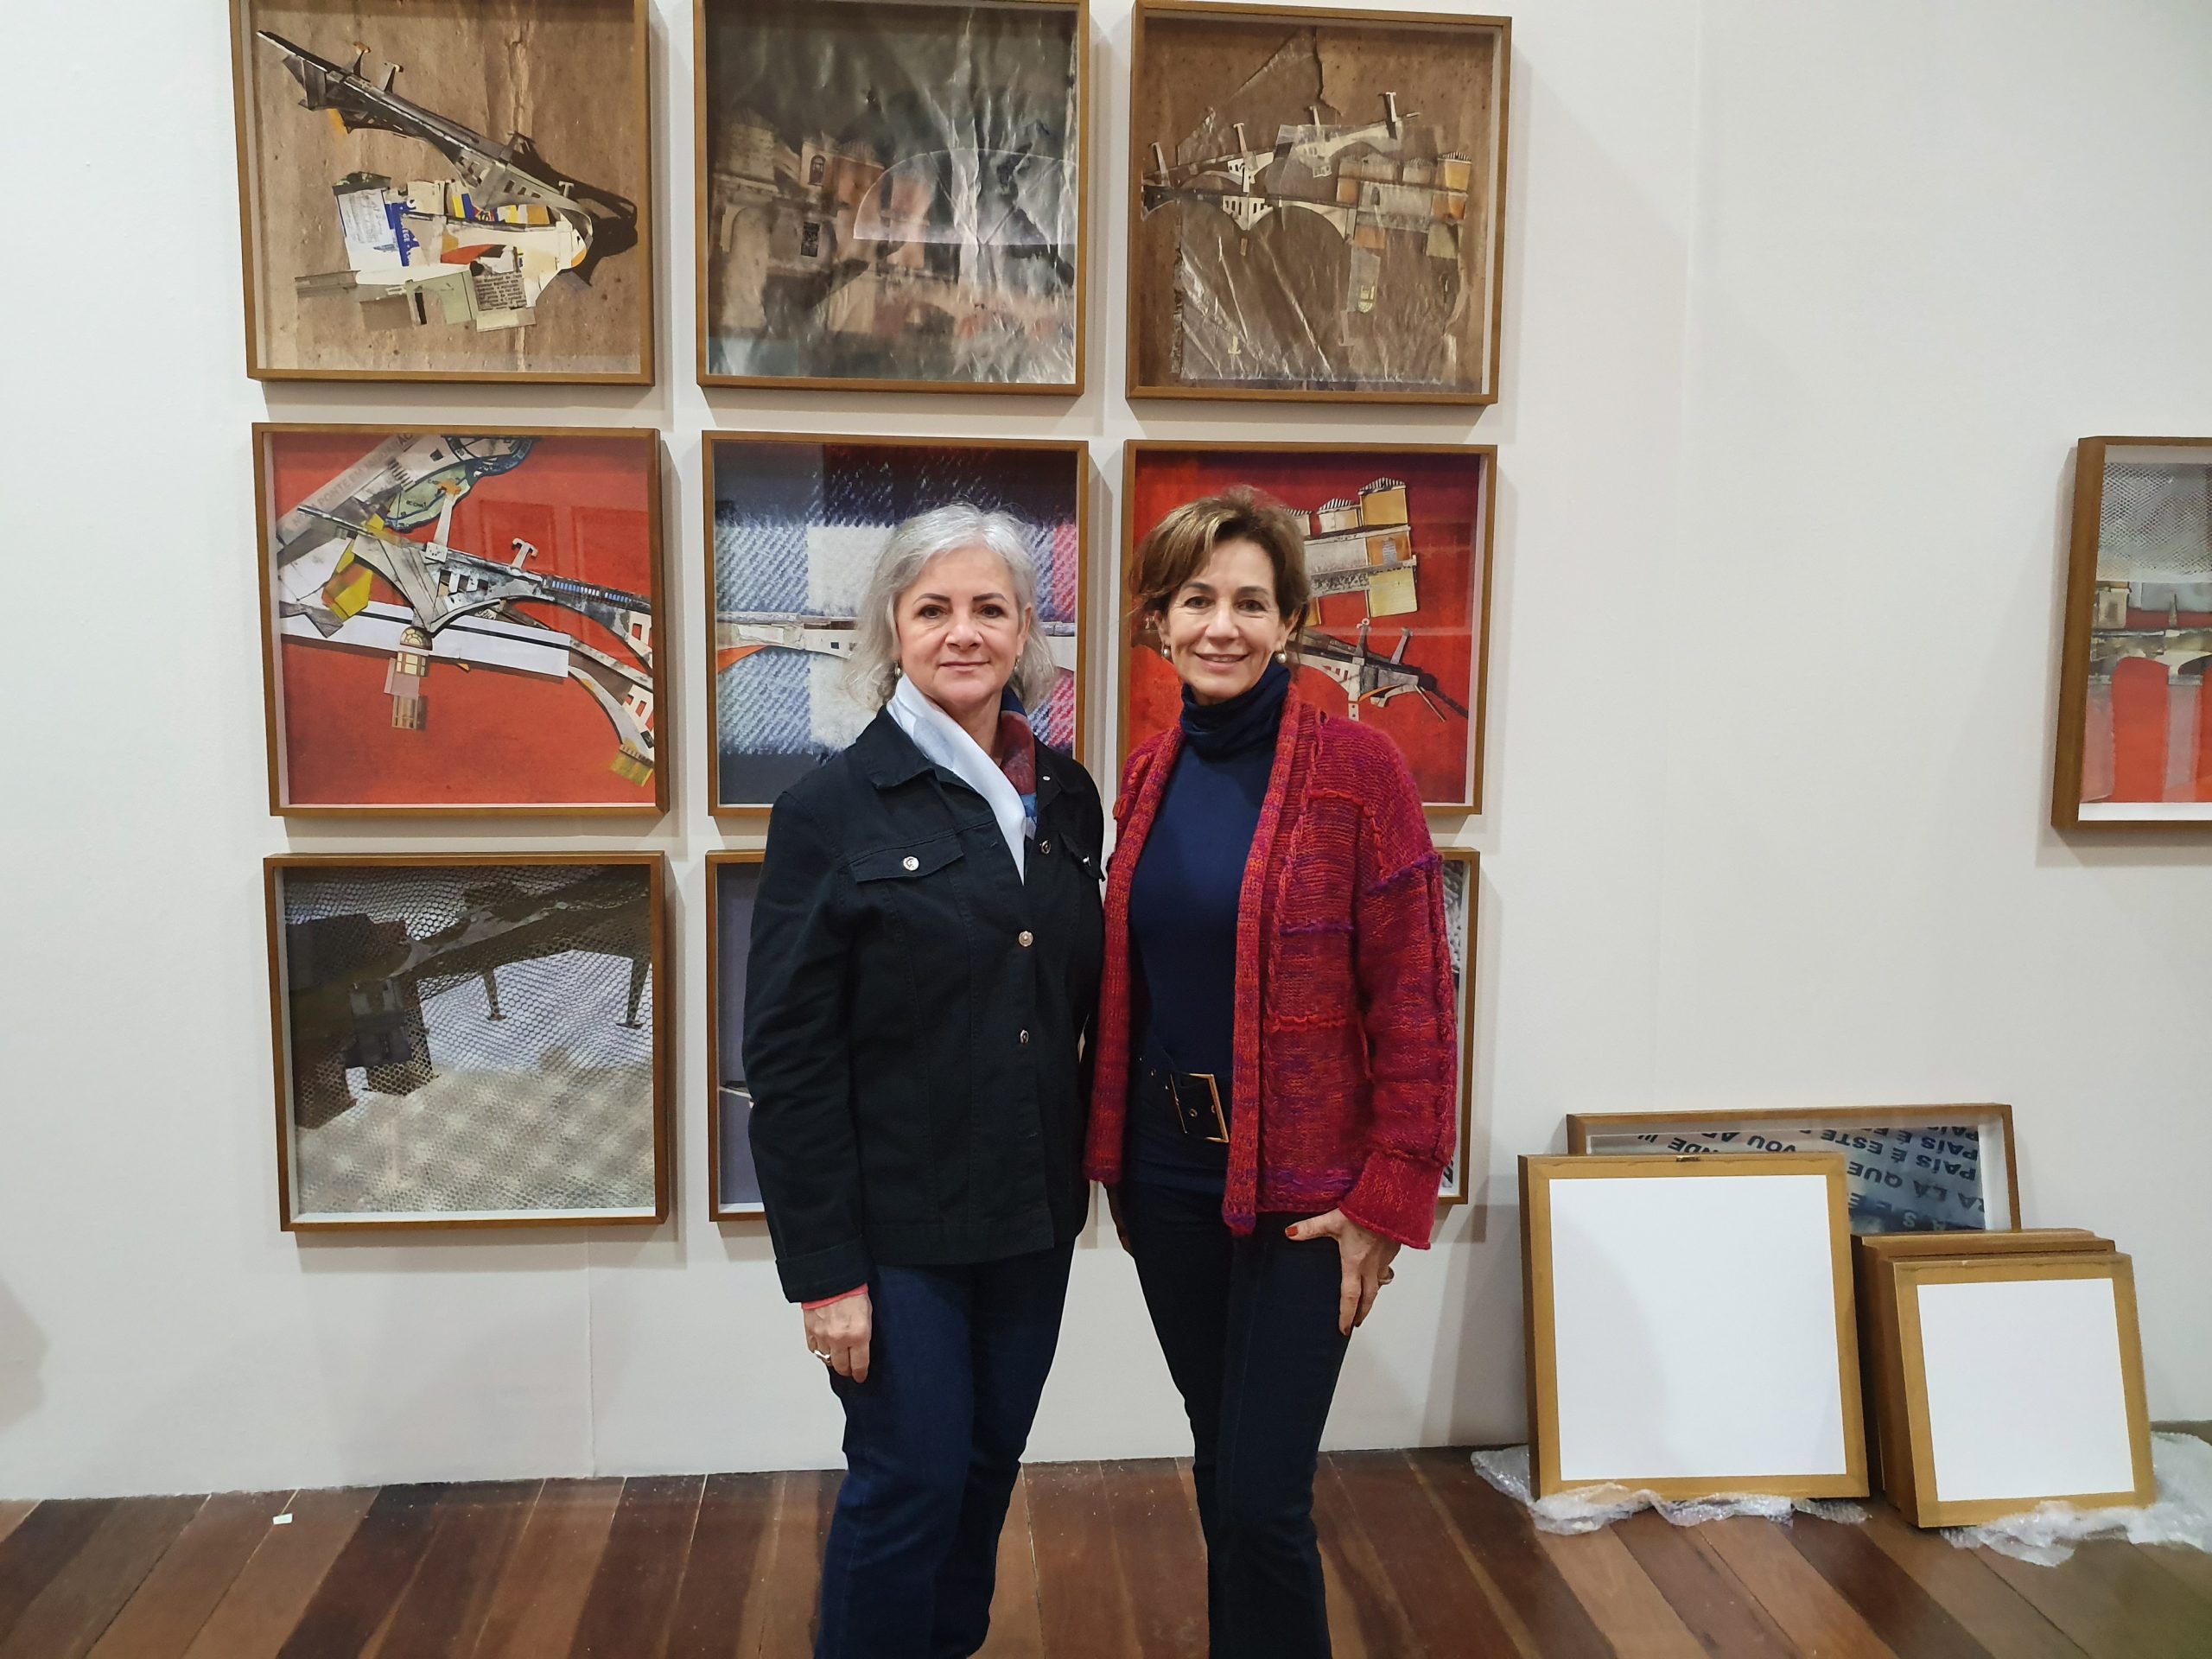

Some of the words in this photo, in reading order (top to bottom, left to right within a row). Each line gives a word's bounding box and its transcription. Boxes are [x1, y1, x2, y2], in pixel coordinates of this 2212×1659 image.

[1821, 1129, 1883, 1155] ESTE
[1896, 1129, 1912, 1143] É
[1891, 1147, 1908, 1163] É
[1921, 1137, 1979, 1161] PAÍS
[1847, 1161, 1903, 1188] QUE
[1916, 1154, 1976, 1181] PAÍS
